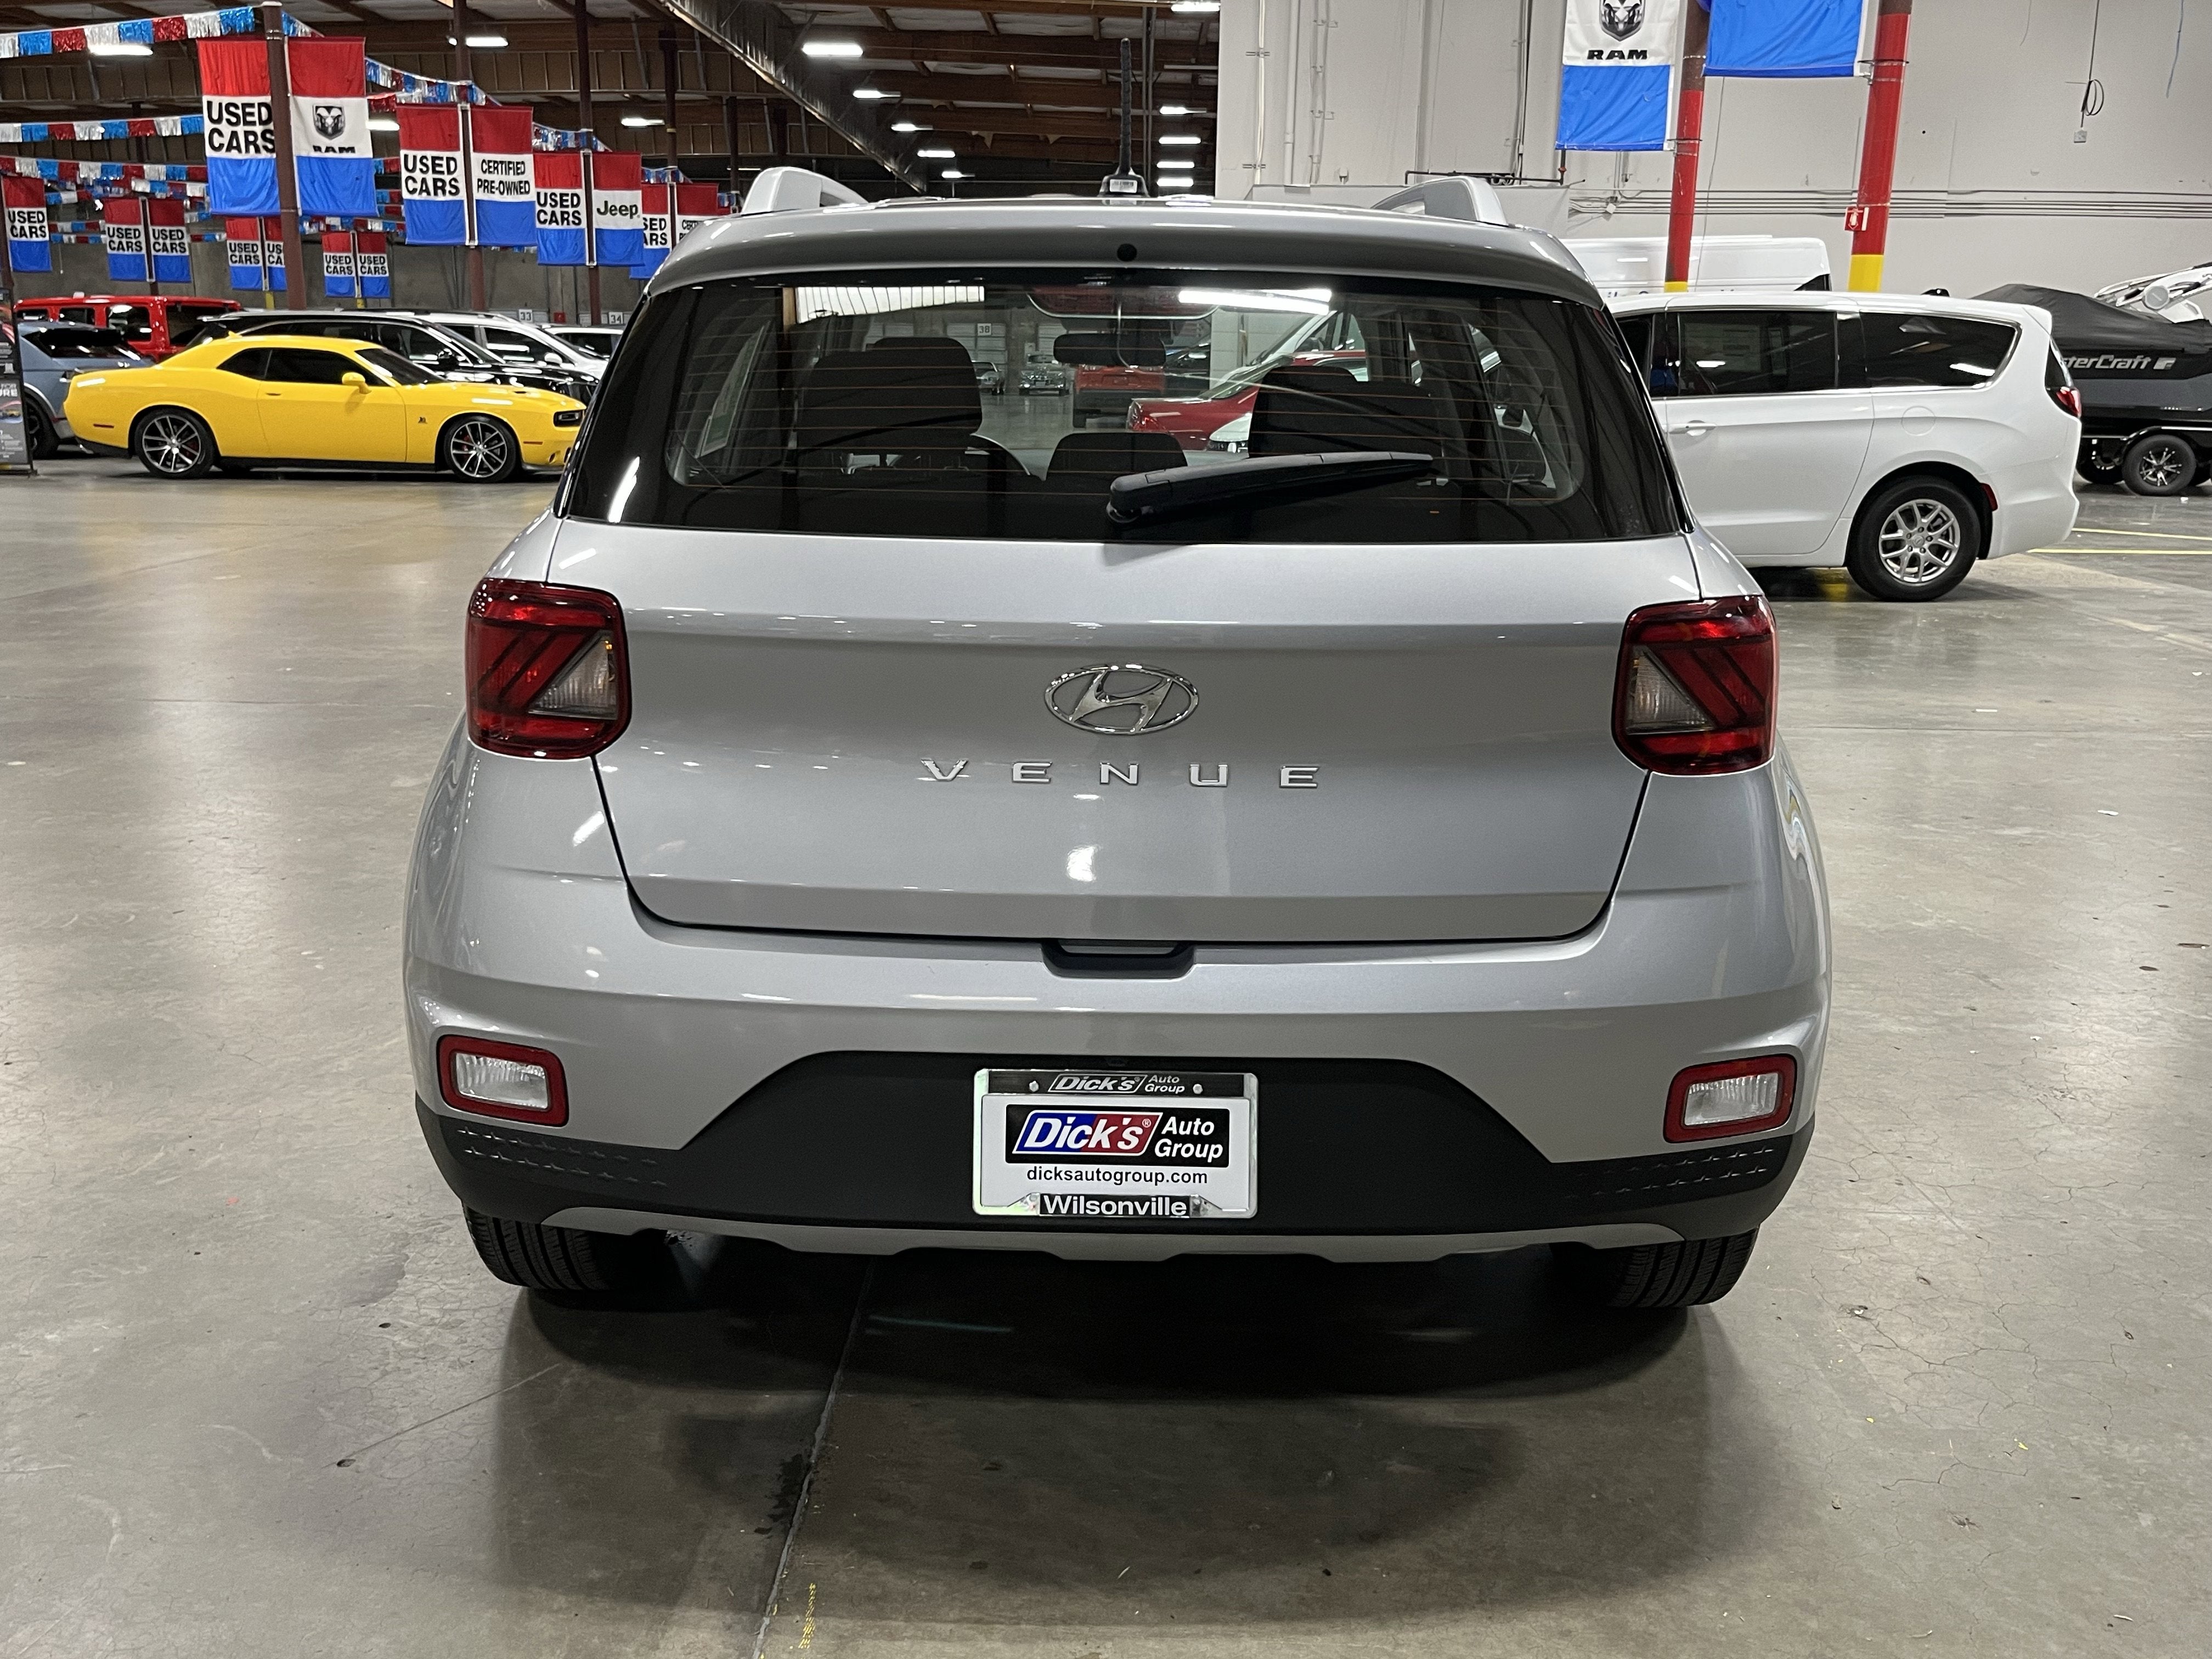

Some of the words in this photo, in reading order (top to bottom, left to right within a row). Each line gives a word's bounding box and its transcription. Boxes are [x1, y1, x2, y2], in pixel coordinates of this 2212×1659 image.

[1587, 49, 1647, 60] RAM
[206, 100, 273, 127] USED
[208, 128, 274, 154] CARS
[313, 145, 356, 154] RAM
[404, 154, 458, 175] USED
[481, 159, 526, 176] CERTIFIED
[405, 176, 460, 196] CARS
[477, 178, 531, 196] PRE-OWNED
[537, 191, 581, 208] USED
[596, 200, 638, 219] Jeep
[8, 211, 45, 223] USED
[537, 209, 582, 226] CARS
[642, 217, 667, 231] SED
[10, 225, 47, 238] CARS
[108, 227, 141, 239] USED
[152, 228, 184, 240] USED
[109, 240, 143, 252] CARS
[153, 241, 187, 253] CARS
[229, 242, 258, 253] USED
[267, 243, 282, 254] US
[230, 254, 260, 265] CARS
[268, 255, 283, 266] CA
[325, 255, 352, 265] USED
[359, 255, 386, 266] USED
[326, 265, 353, 275] CARS
[360, 266, 387, 275] CARS
[520, 312, 532, 321] 33
[611, 314, 622, 324] 34
[978, 325, 990, 334] 38
[2063, 354, 2152, 369] terCraft
[920, 759, 1319, 788] VENUE
[1054, 1075, 1135, 1091] Dick's
[1148, 1074, 1180, 1084] Auto
[1144, 1083, 1186, 1094] Group
[1161, 1116, 1215, 1136] Auto
[1024, 1116, 1143, 1150] Dick's
[1155, 1138, 1223, 1163] Group
[1026, 1166, 1208, 1186] dicksautogroup.com
[1043, 1194, 1187, 1216] Wilsonville
